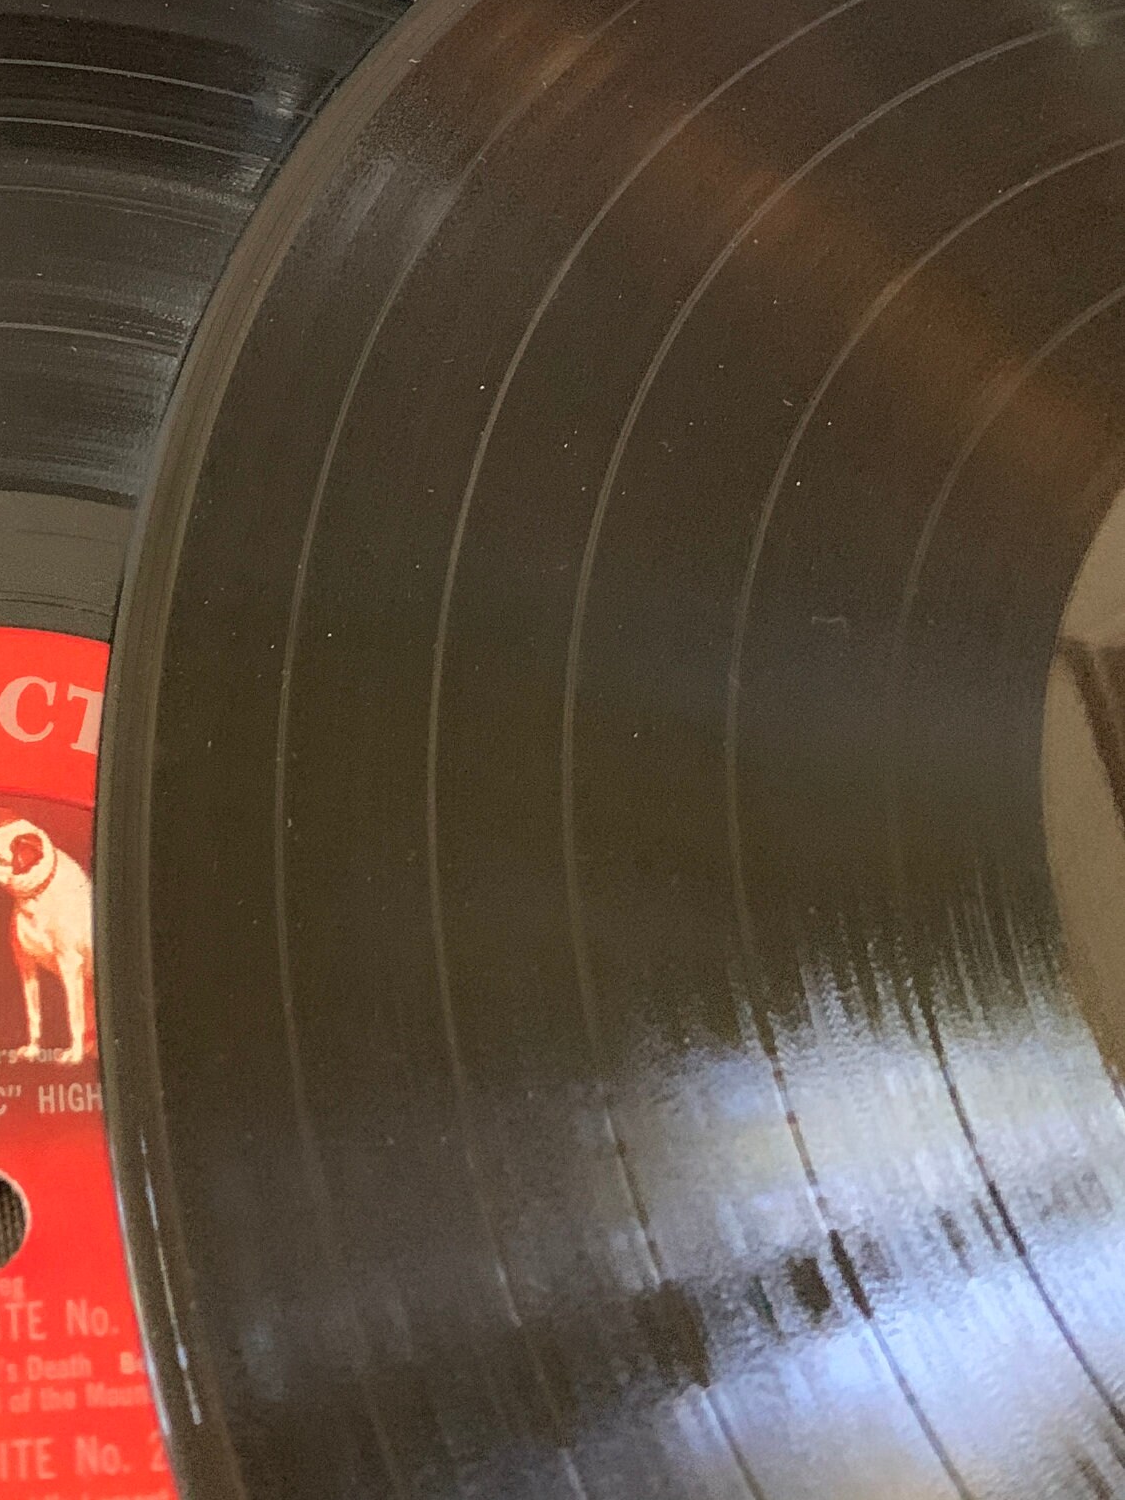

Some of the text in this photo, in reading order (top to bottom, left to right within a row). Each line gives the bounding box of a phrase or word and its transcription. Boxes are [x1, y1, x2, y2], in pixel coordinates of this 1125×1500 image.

[38, 1082, 104, 1114] HIGH
[65, 1298, 119, 1338] No.
[75, 1434, 132, 1477] No.
